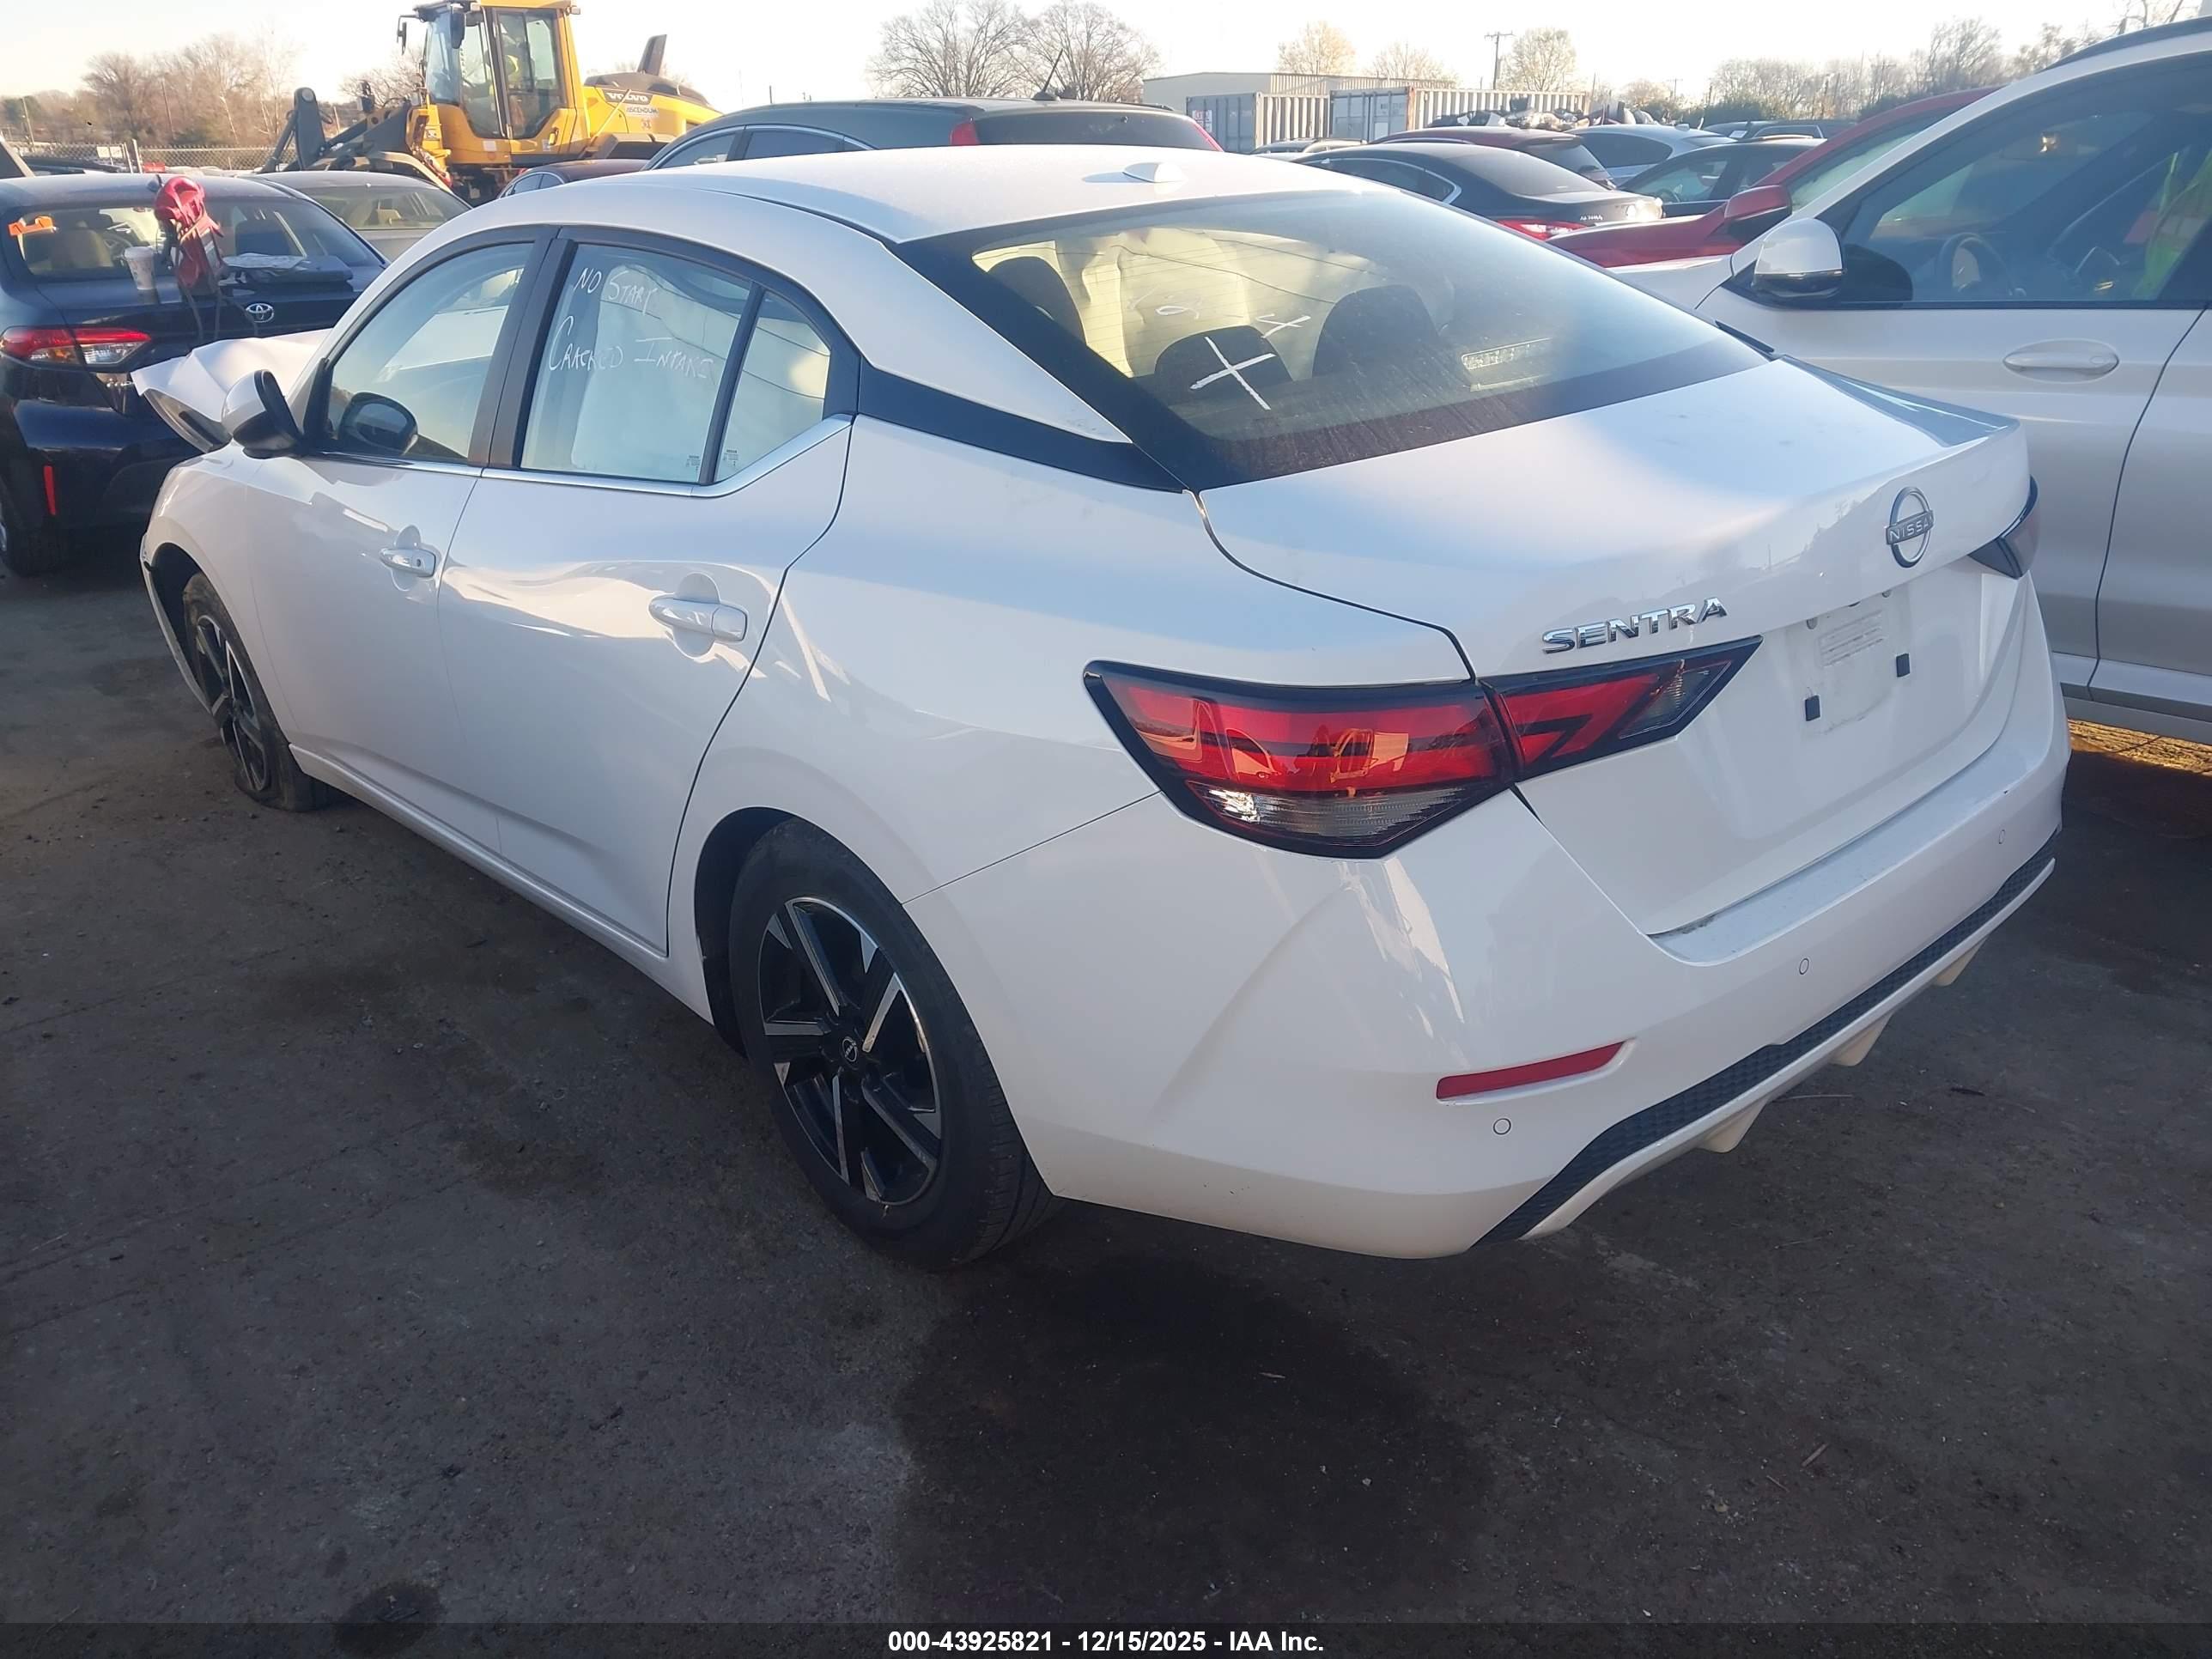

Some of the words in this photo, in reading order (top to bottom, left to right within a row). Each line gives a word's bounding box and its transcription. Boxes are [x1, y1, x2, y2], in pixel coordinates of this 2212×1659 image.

[573, 267, 603, 295] NO
[1889, 513, 1934, 543] NISSAN
[1541, 597, 1729, 654] SENTRA
